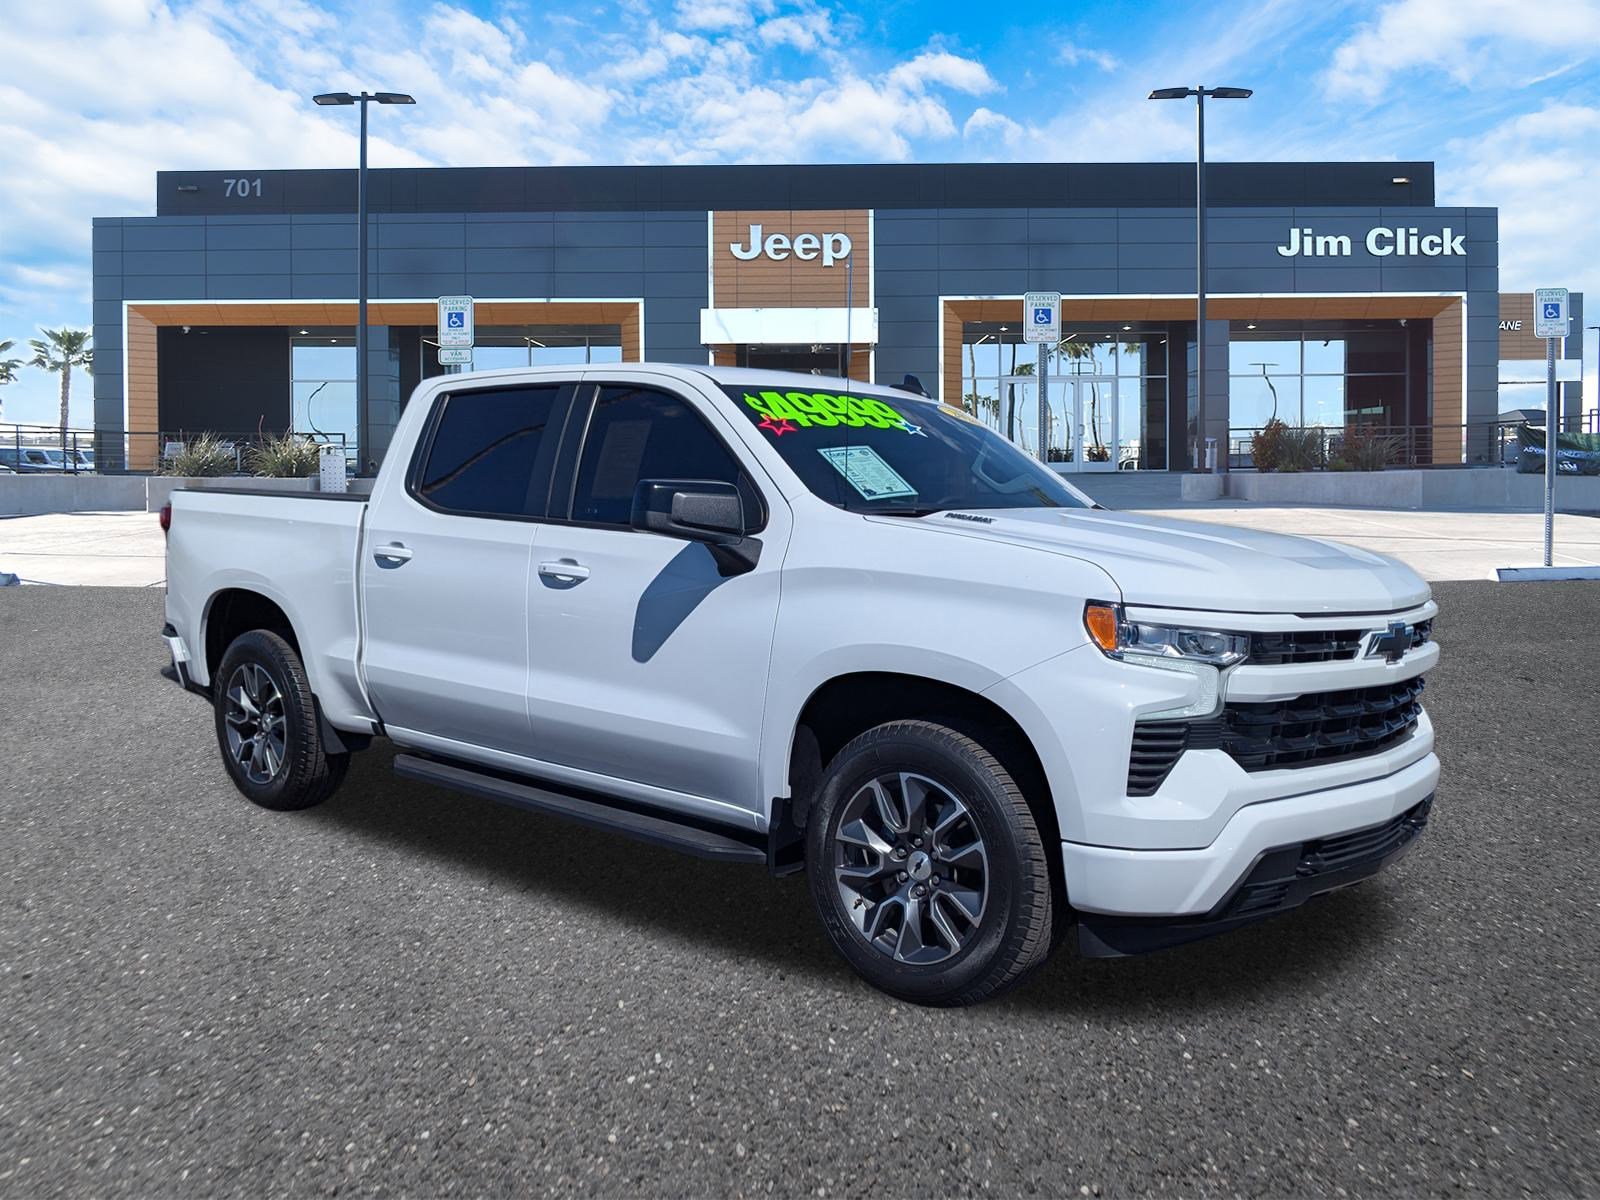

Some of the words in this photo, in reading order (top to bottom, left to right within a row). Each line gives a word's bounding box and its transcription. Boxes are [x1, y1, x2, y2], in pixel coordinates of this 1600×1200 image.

[223, 178, 261, 197] 701
[730, 224, 852, 267] Jeep
[1277, 227, 1351, 257] Jim
[1365, 227, 1467, 257] Click
